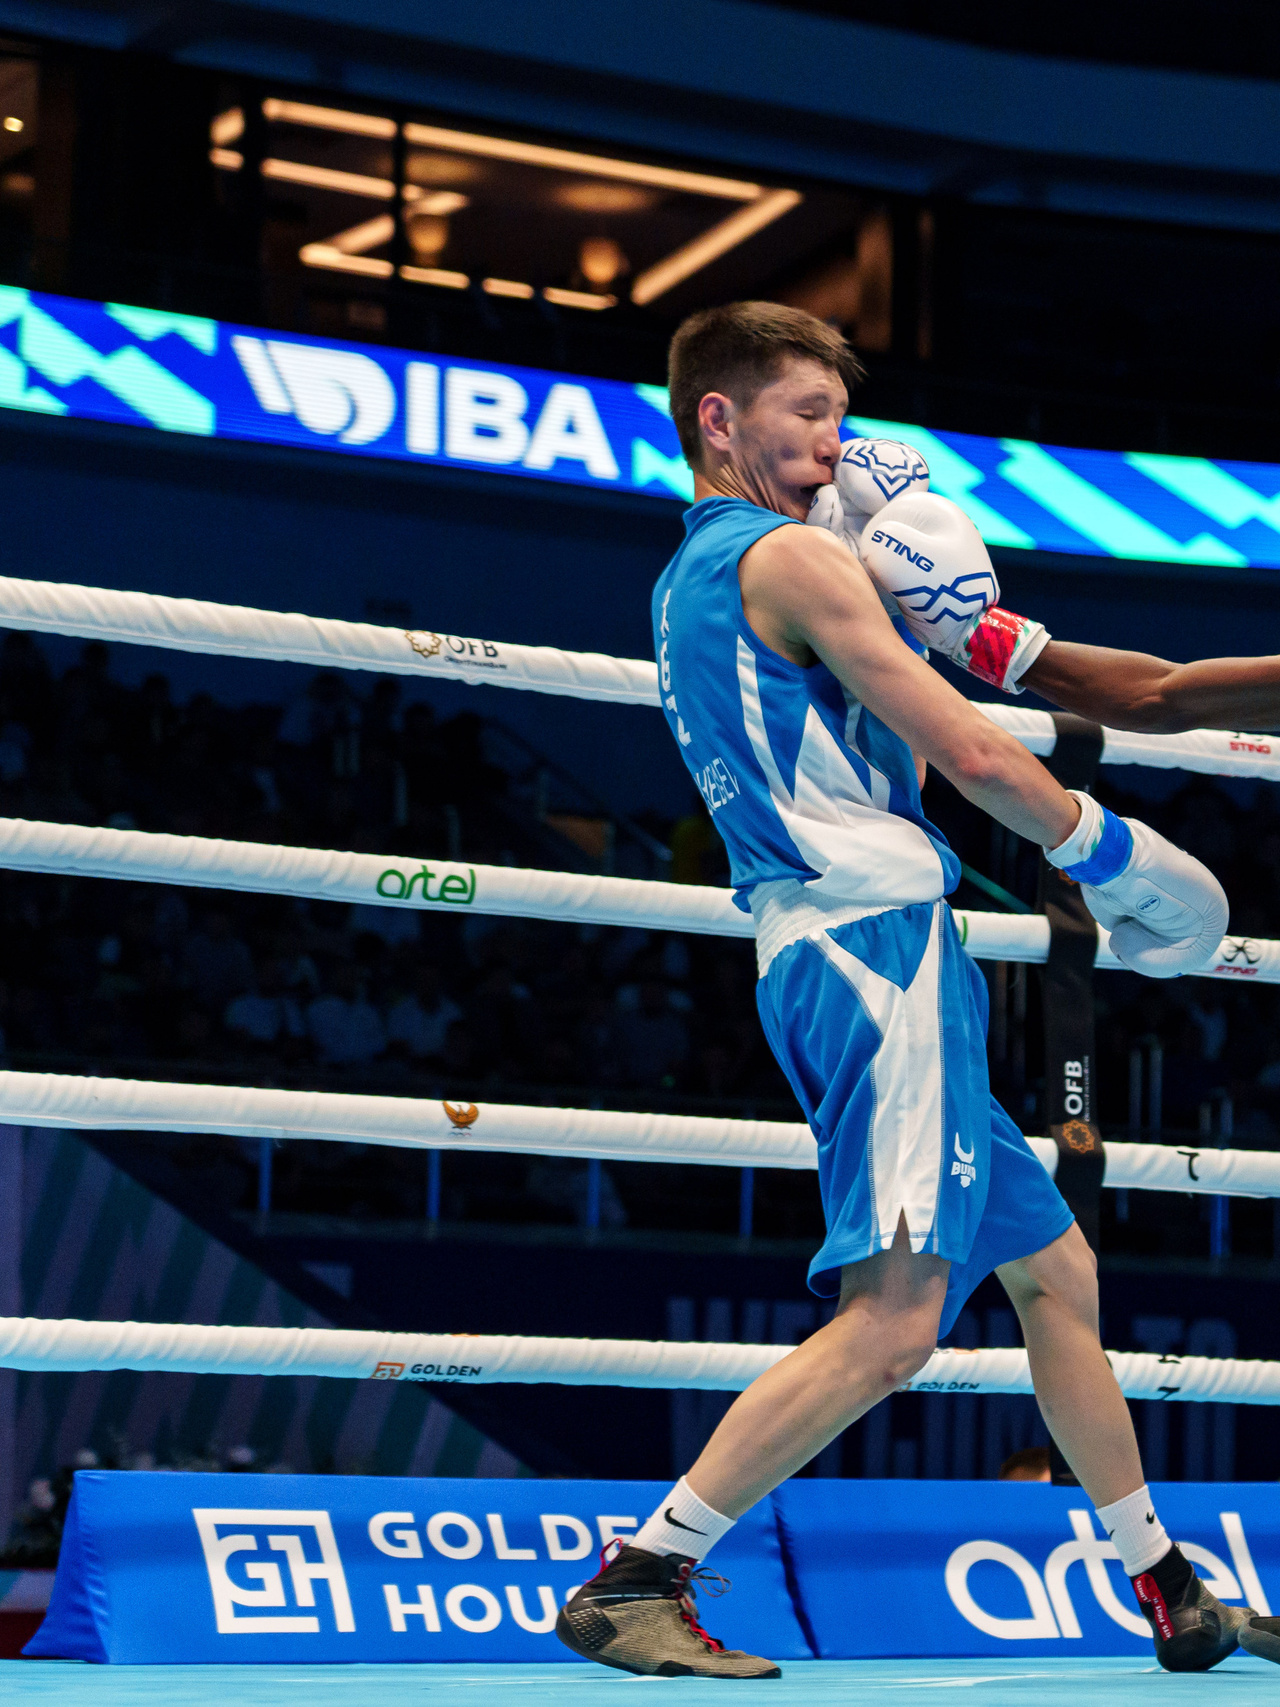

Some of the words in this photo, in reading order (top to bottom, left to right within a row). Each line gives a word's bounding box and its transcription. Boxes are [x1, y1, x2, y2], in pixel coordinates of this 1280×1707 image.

[405, 360, 621, 481] IBA
[871, 529, 935, 573] STING
[376, 864, 477, 905] artel
[1064, 1060, 1083, 1115] OFB
[410, 1363, 482, 1377] GOLDEN
[367, 1511, 650, 1561] GOLDE
[381, 1584, 582, 1634] HOU
